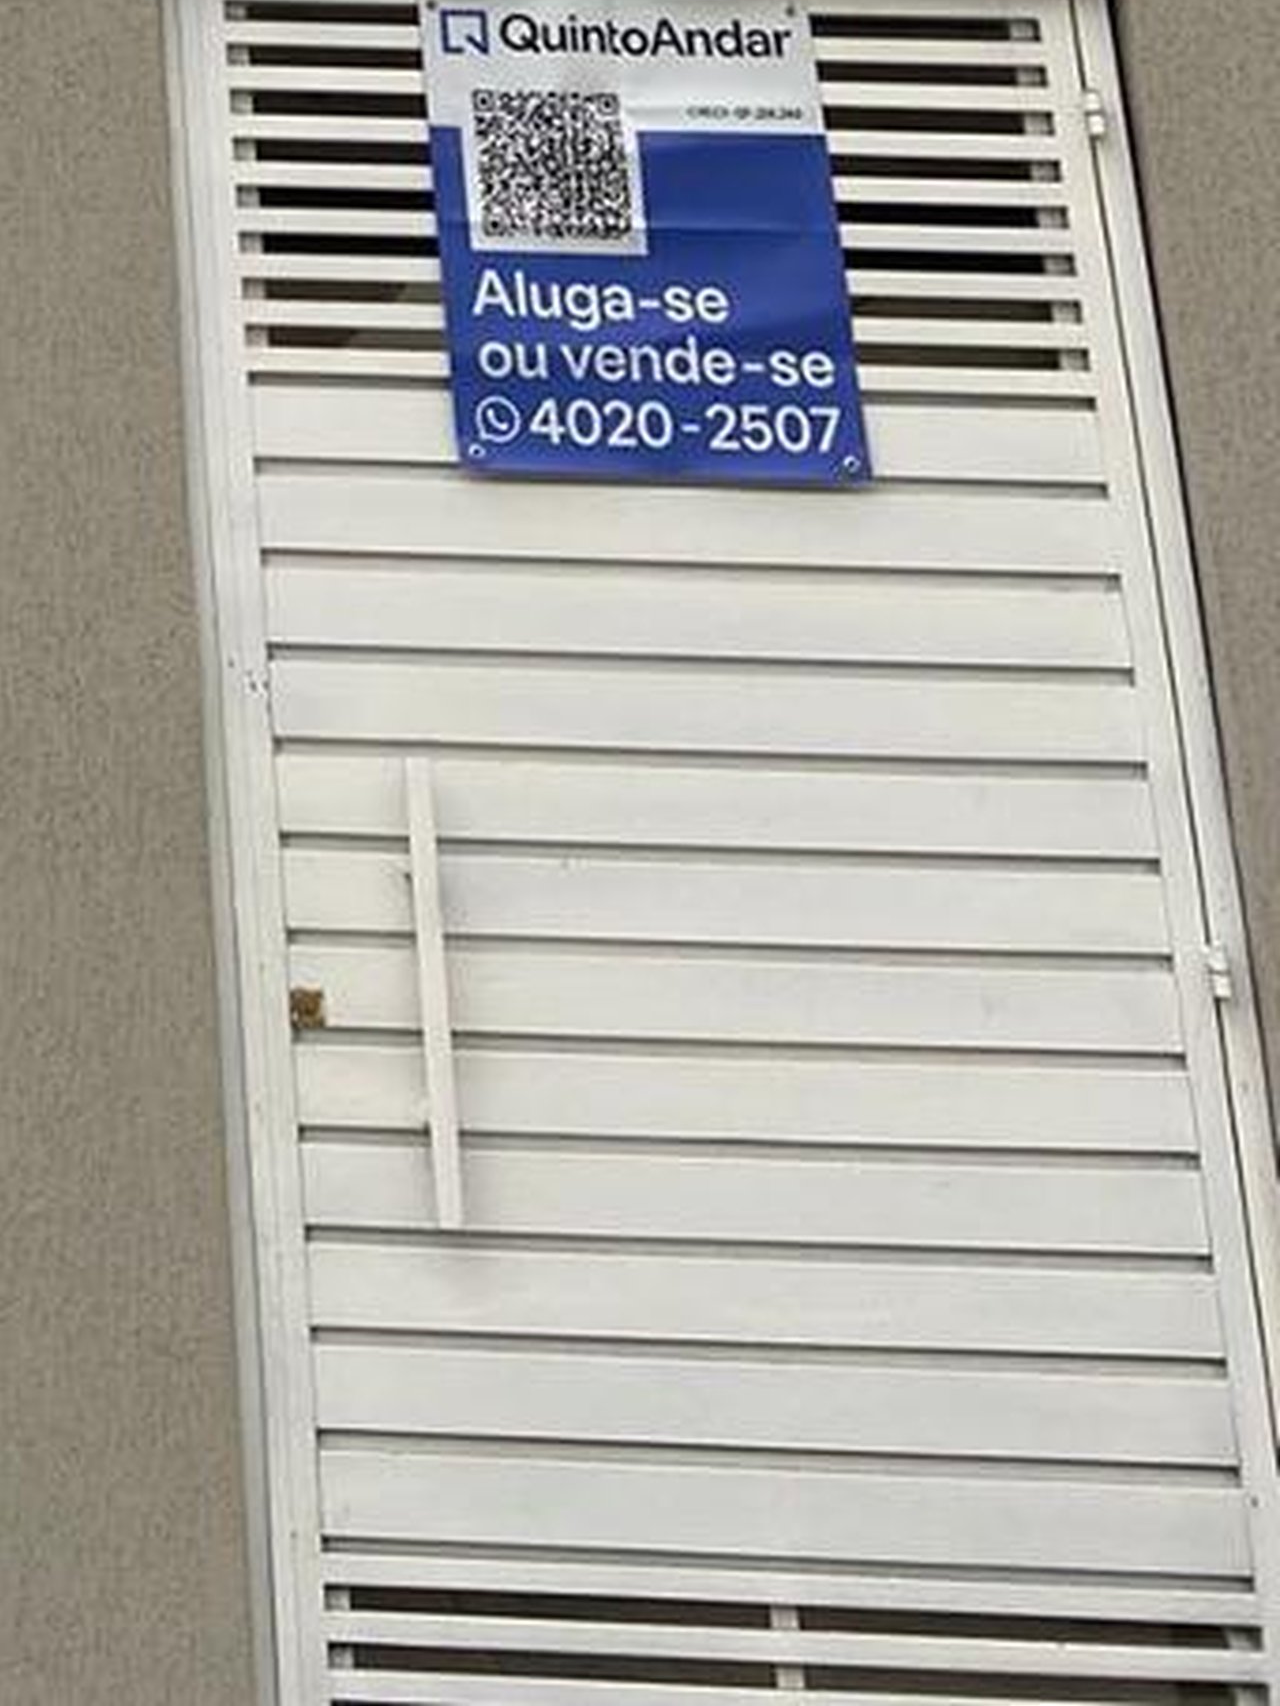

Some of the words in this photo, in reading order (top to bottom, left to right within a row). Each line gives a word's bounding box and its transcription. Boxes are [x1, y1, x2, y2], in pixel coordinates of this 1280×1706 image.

[499, 13, 792, 58] QuintoAndar
[472, 270, 730, 330] Aluga-se
[478, 341, 549, 379] ou
[561, 336, 835, 387] vende-se
[529, 400, 841, 452] 4020-2507
